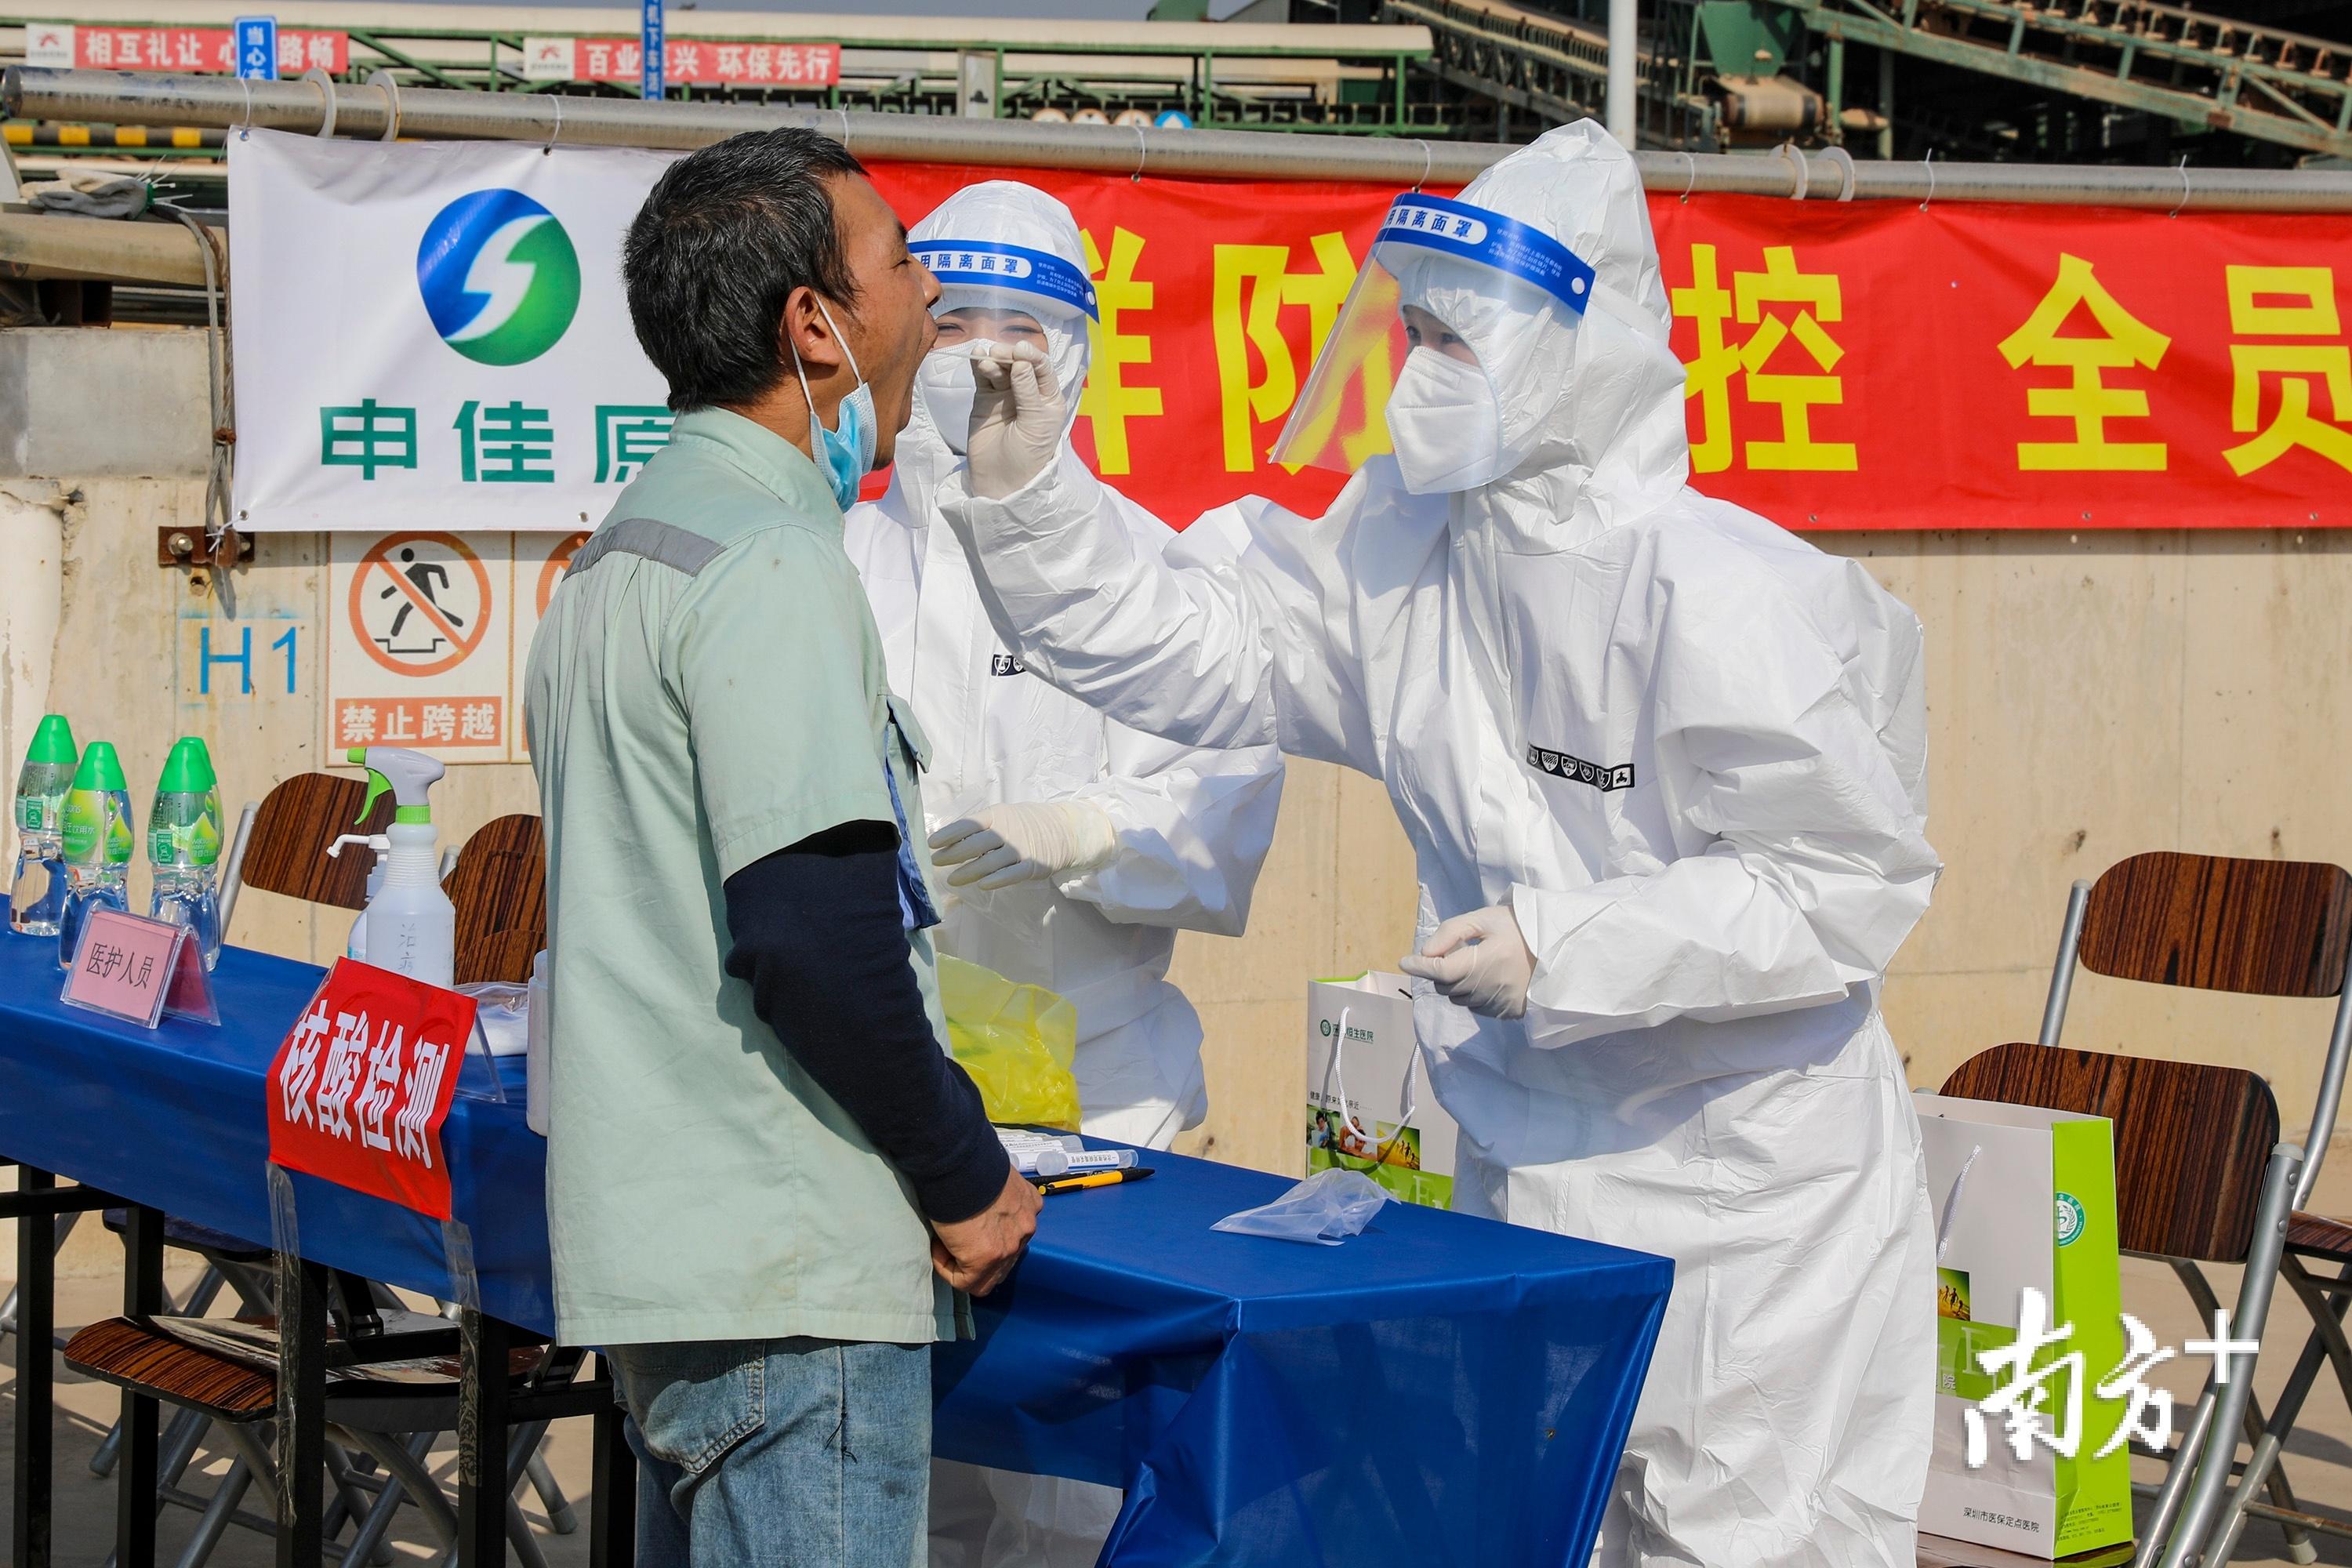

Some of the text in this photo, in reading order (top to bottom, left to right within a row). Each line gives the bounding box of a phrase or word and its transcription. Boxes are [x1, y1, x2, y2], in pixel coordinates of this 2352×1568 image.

[85, 30, 334, 69] 相互礼让 心路畅
[585, 43, 833, 80] 百业兴 环保先行
[1997, 252, 2352, 477] 全员
[319, 398, 679, 484] 申佳原
[200, 626, 296, 695] H1
[341, 703, 495, 743] 禁止跨越
[86, 942, 154, 989] 医护人员
[279, 999, 451, 1169] 核酸检测
[1962, 1506, 2040, 1534] 深圳市医保定点医院
